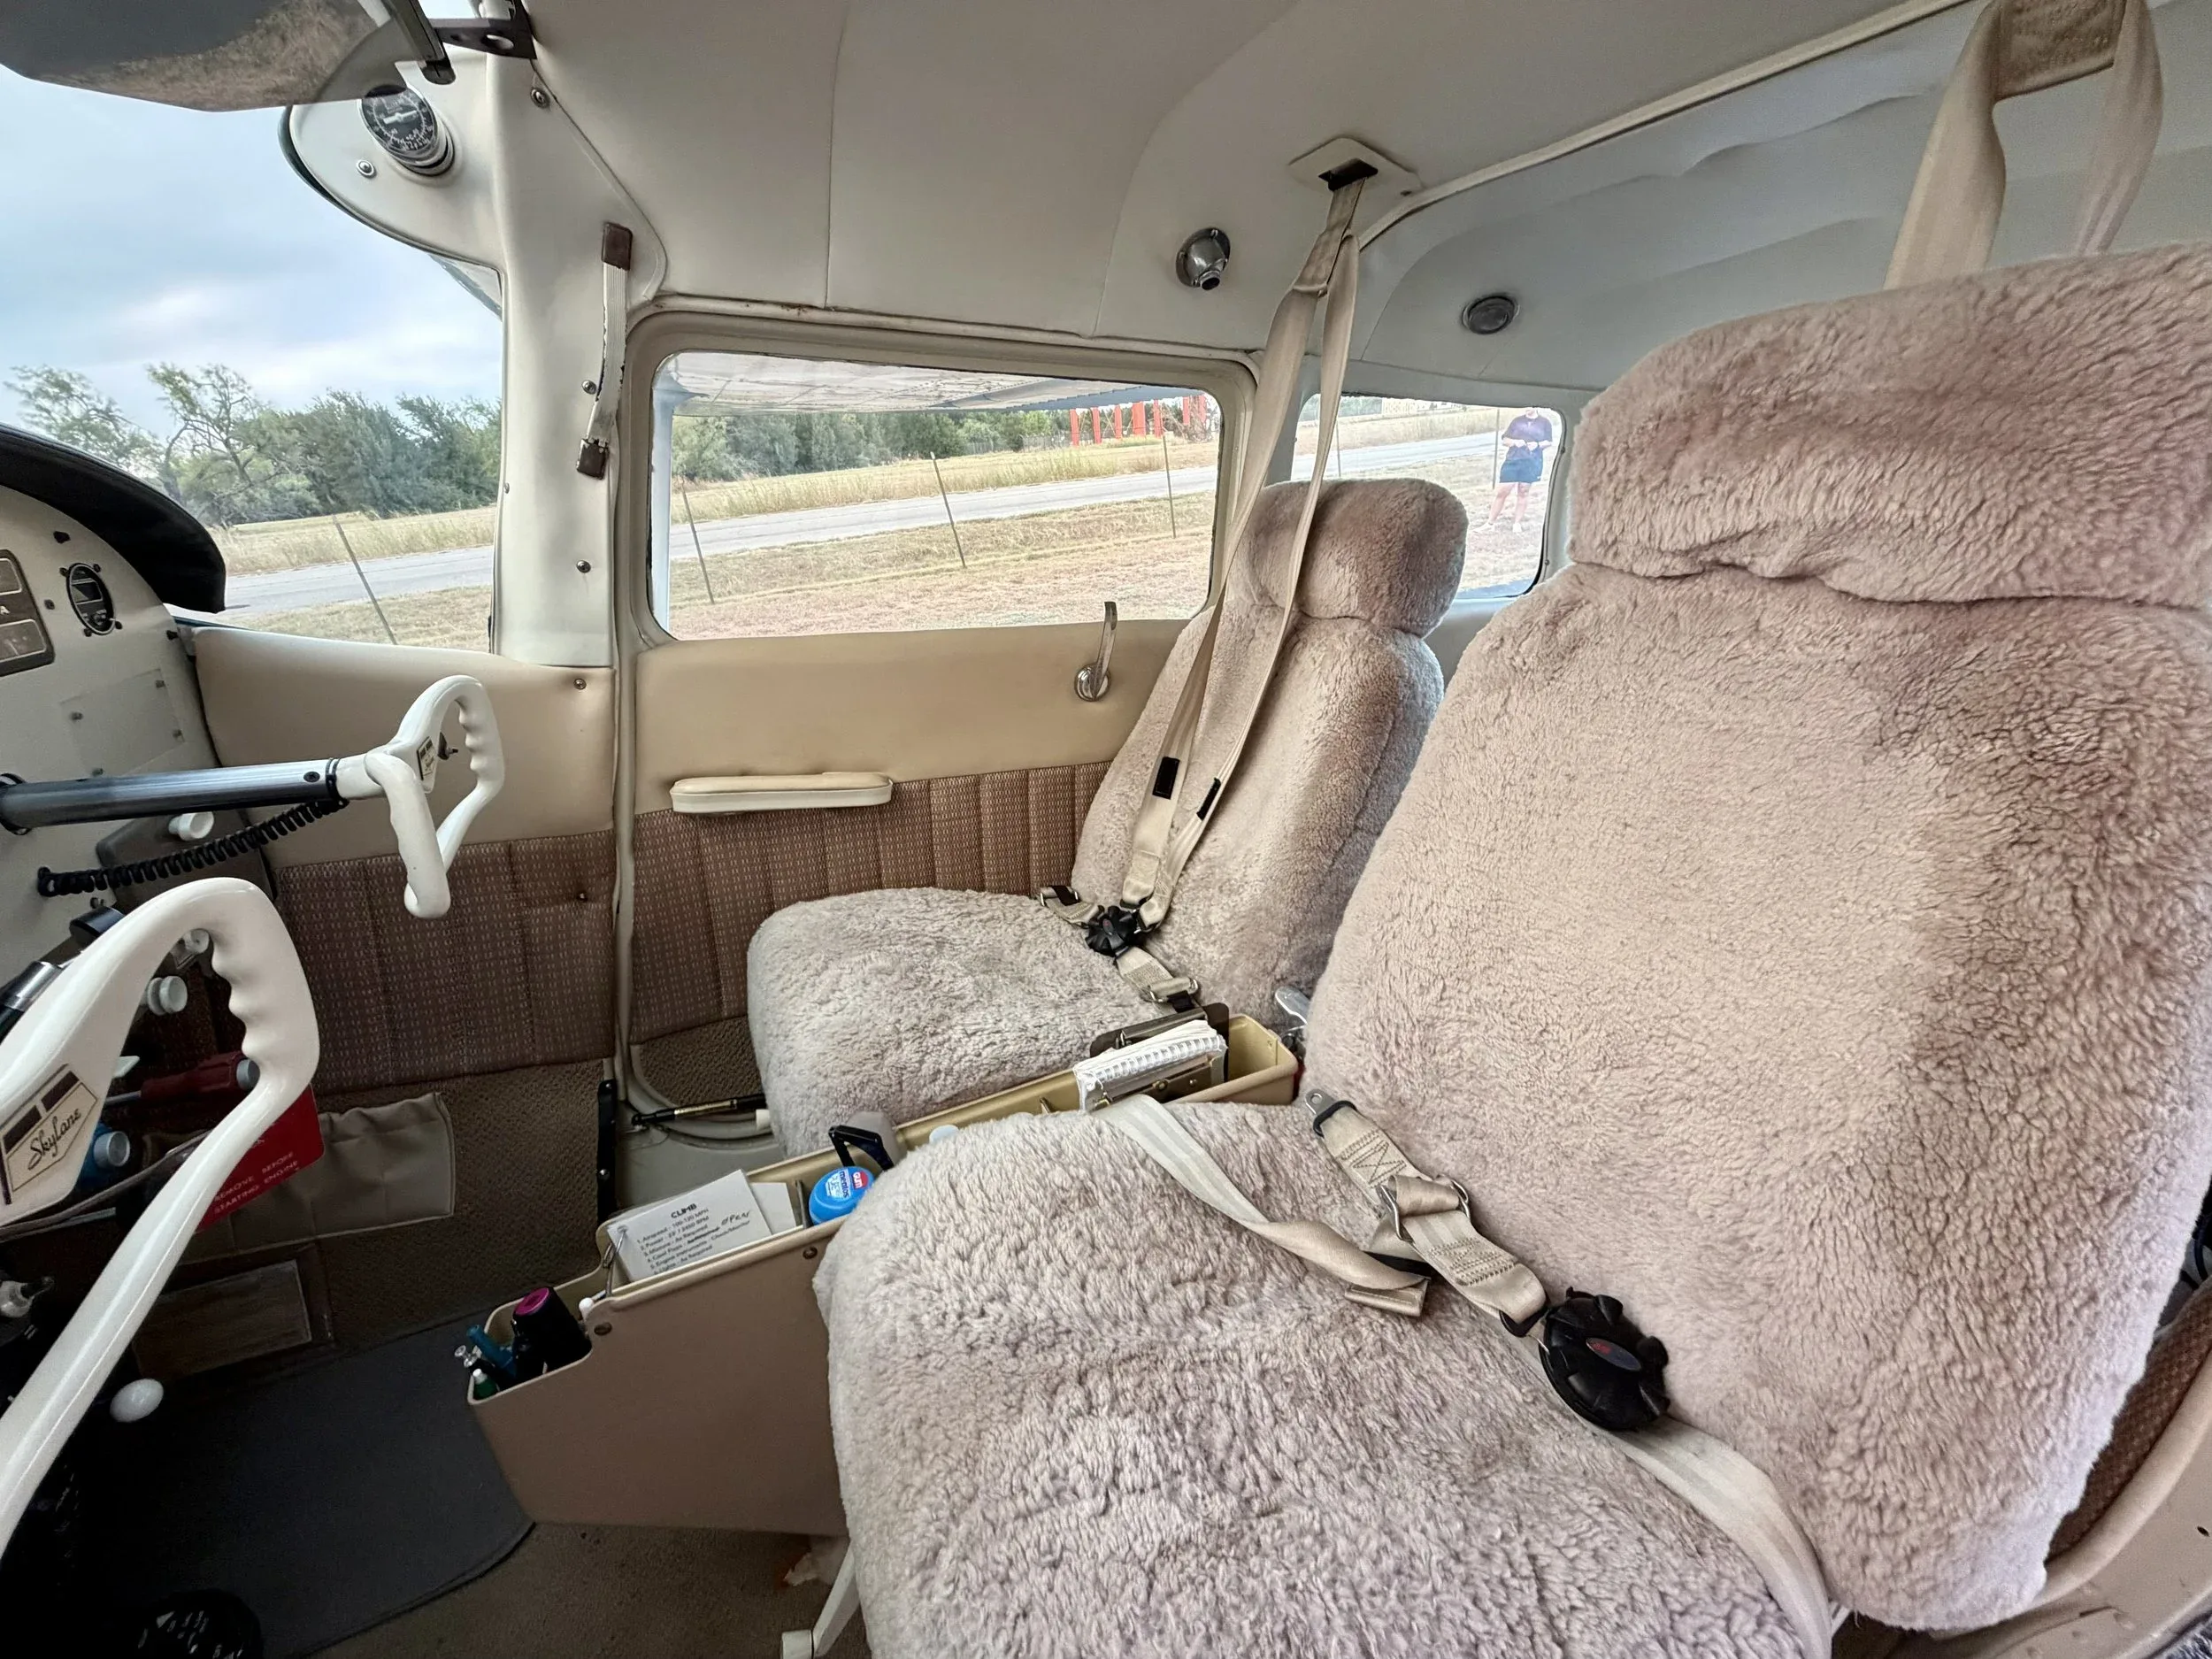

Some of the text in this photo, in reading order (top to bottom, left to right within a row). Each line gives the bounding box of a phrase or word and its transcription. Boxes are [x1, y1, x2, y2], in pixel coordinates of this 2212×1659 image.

[840, 1171, 849, 1198] mentos
[671, 1203, 697, 1218] CLIMB
[642, 1226, 668, 1241] Airspeed
[695, 1209, 709, 1217] MPH
[646, 1237, 664, 1248] Power
[695, 1216, 710, 1225] RPM
[649, 1242, 670, 1254] Mixture
[683, 1225, 708, 1238] Required
[652, 1250, 667, 1260] Cowl
[667, 1244, 682, 1253] Flaps
[657, 1255, 675, 1266] Engine
[688, 1245, 712, 1257] Required
